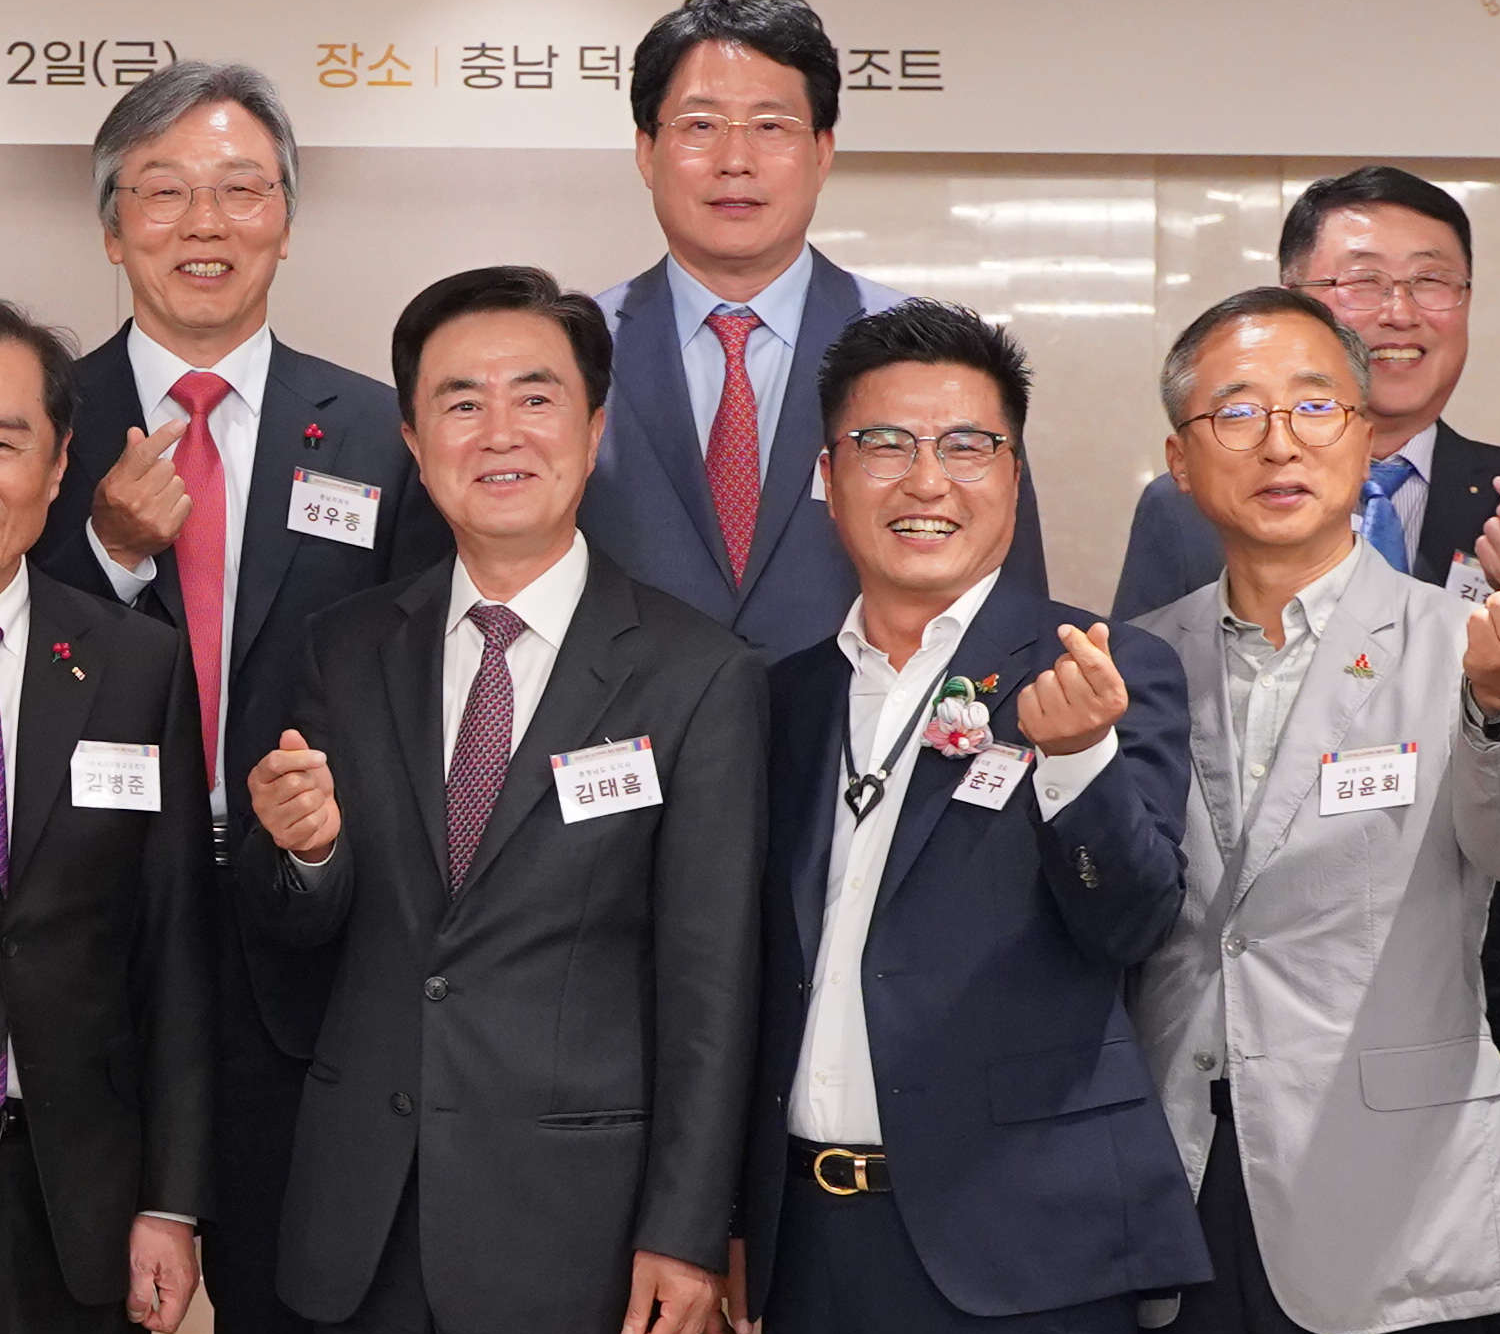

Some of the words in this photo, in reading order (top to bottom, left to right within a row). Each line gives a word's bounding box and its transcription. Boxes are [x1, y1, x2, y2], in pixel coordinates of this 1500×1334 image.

[316, 43, 413, 89] 장소
[460, 43, 559, 90] 충남
[578, 44, 635, 91] 덕
[833, 48, 944, 91] 조트
[304, 503, 361, 531] 성우종
[575, 772, 642, 804] 김태흠
[1337, 773, 1399, 800] 김윤회
